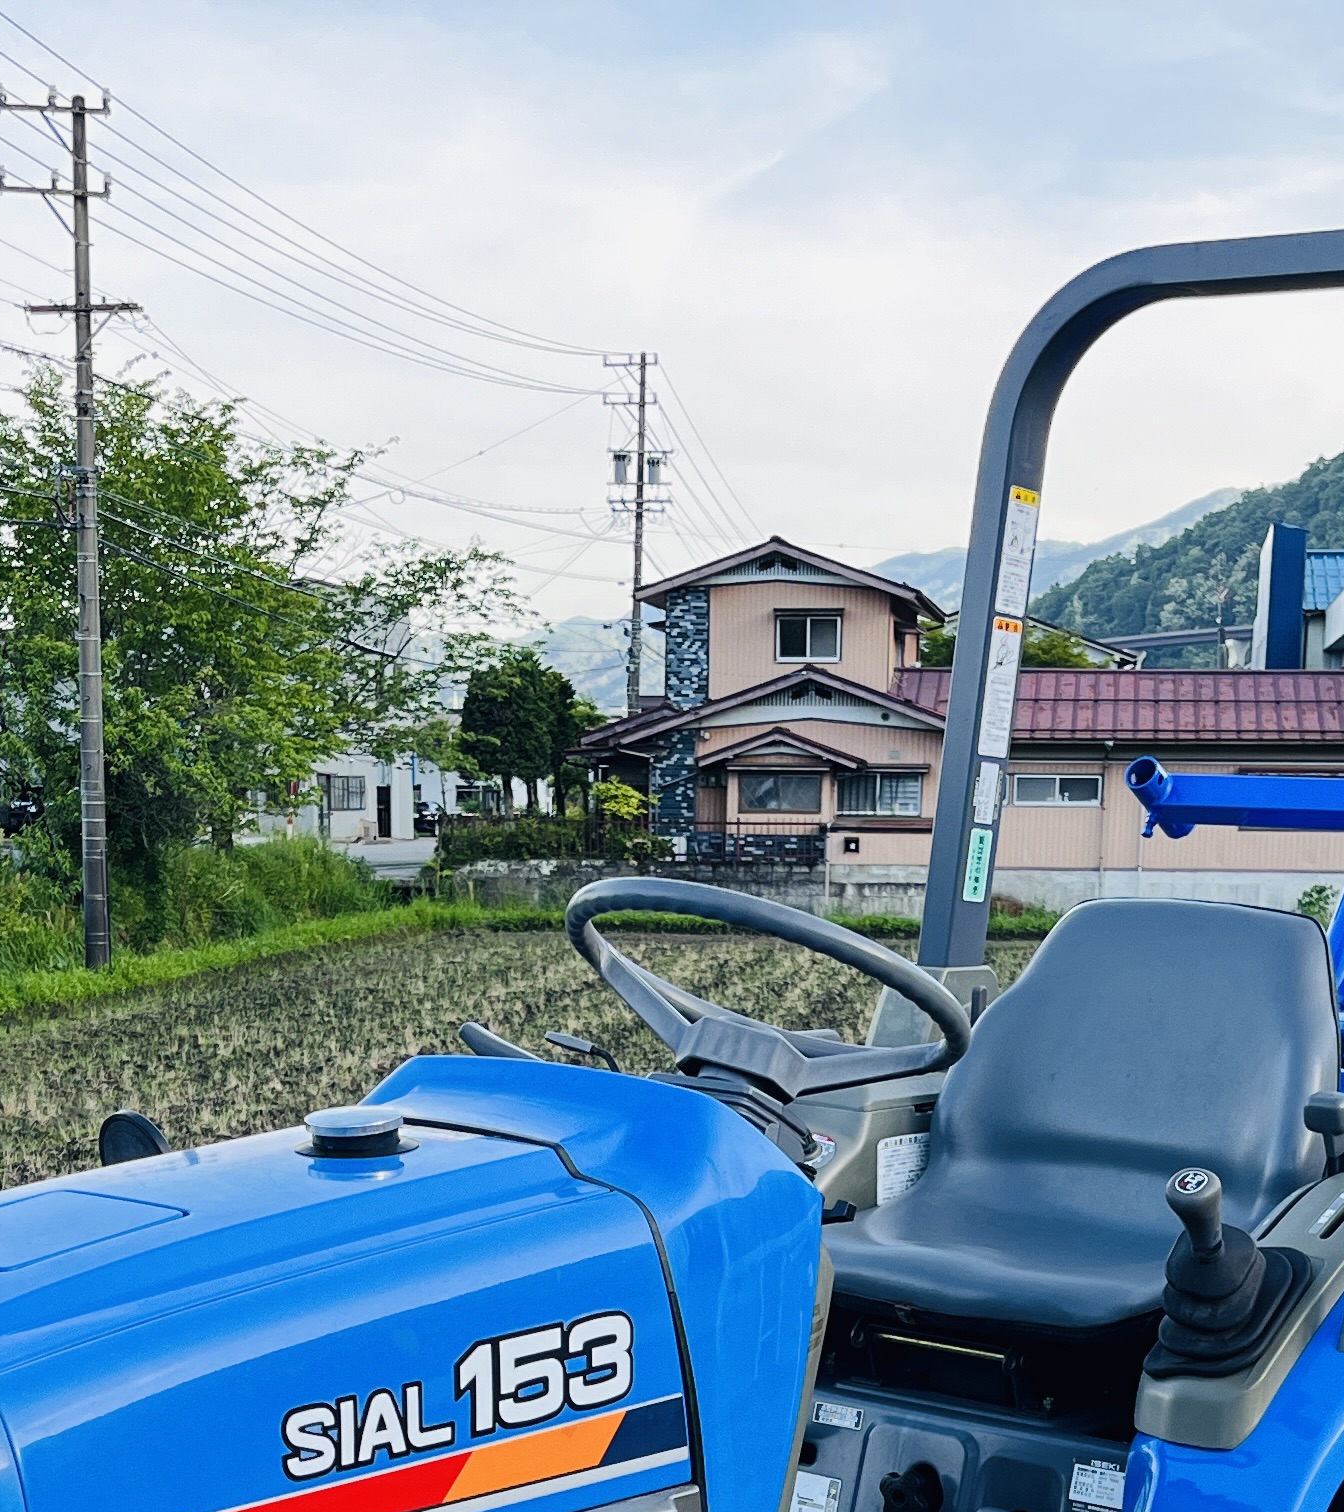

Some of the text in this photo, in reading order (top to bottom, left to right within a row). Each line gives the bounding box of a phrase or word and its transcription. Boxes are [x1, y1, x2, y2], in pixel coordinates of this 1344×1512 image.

[283, 1312, 633, 1481] SIAL 153
[1090, 1458, 1120, 1472] ISEKI
